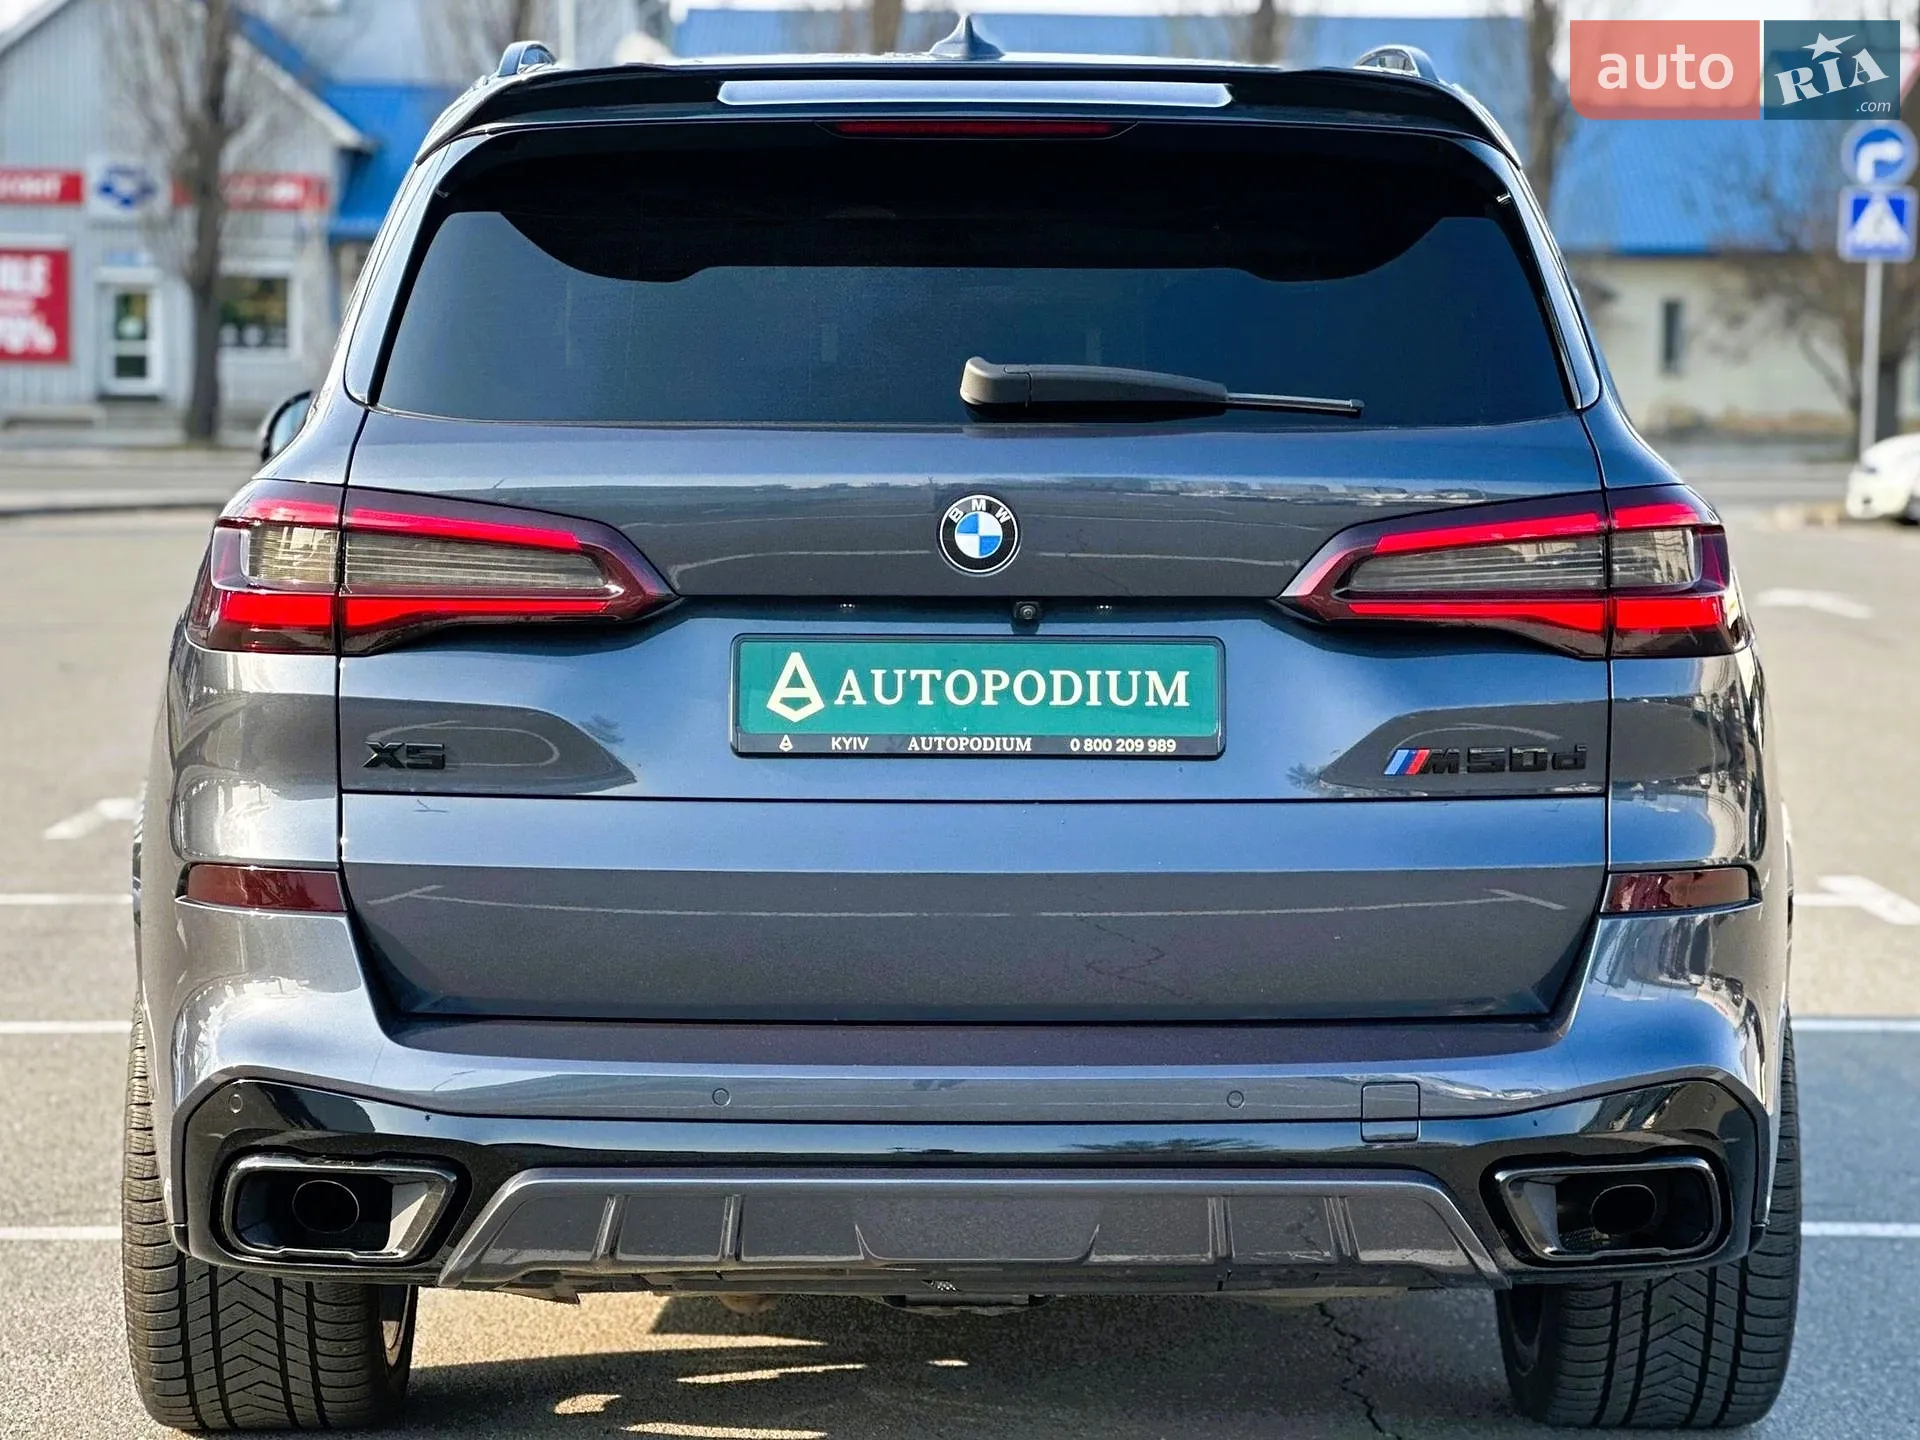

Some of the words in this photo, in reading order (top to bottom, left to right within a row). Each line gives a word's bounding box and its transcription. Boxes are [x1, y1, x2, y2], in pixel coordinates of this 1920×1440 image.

[948, 498, 1011, 523] BMW
[834, 669, 1190, 708] AUTOPODIUM
[362, 741, 446, 770] X5
[831, 736, 868, 750] KYIV
[907, 736, 1033, 752] AUTOPODIUM
[1070, 738, 1080, 751] 0
[1083, 738, 1113, 752] 800
[1115, 738, 1145, 752] 209
[1147, 738, 1177, 752] 989
